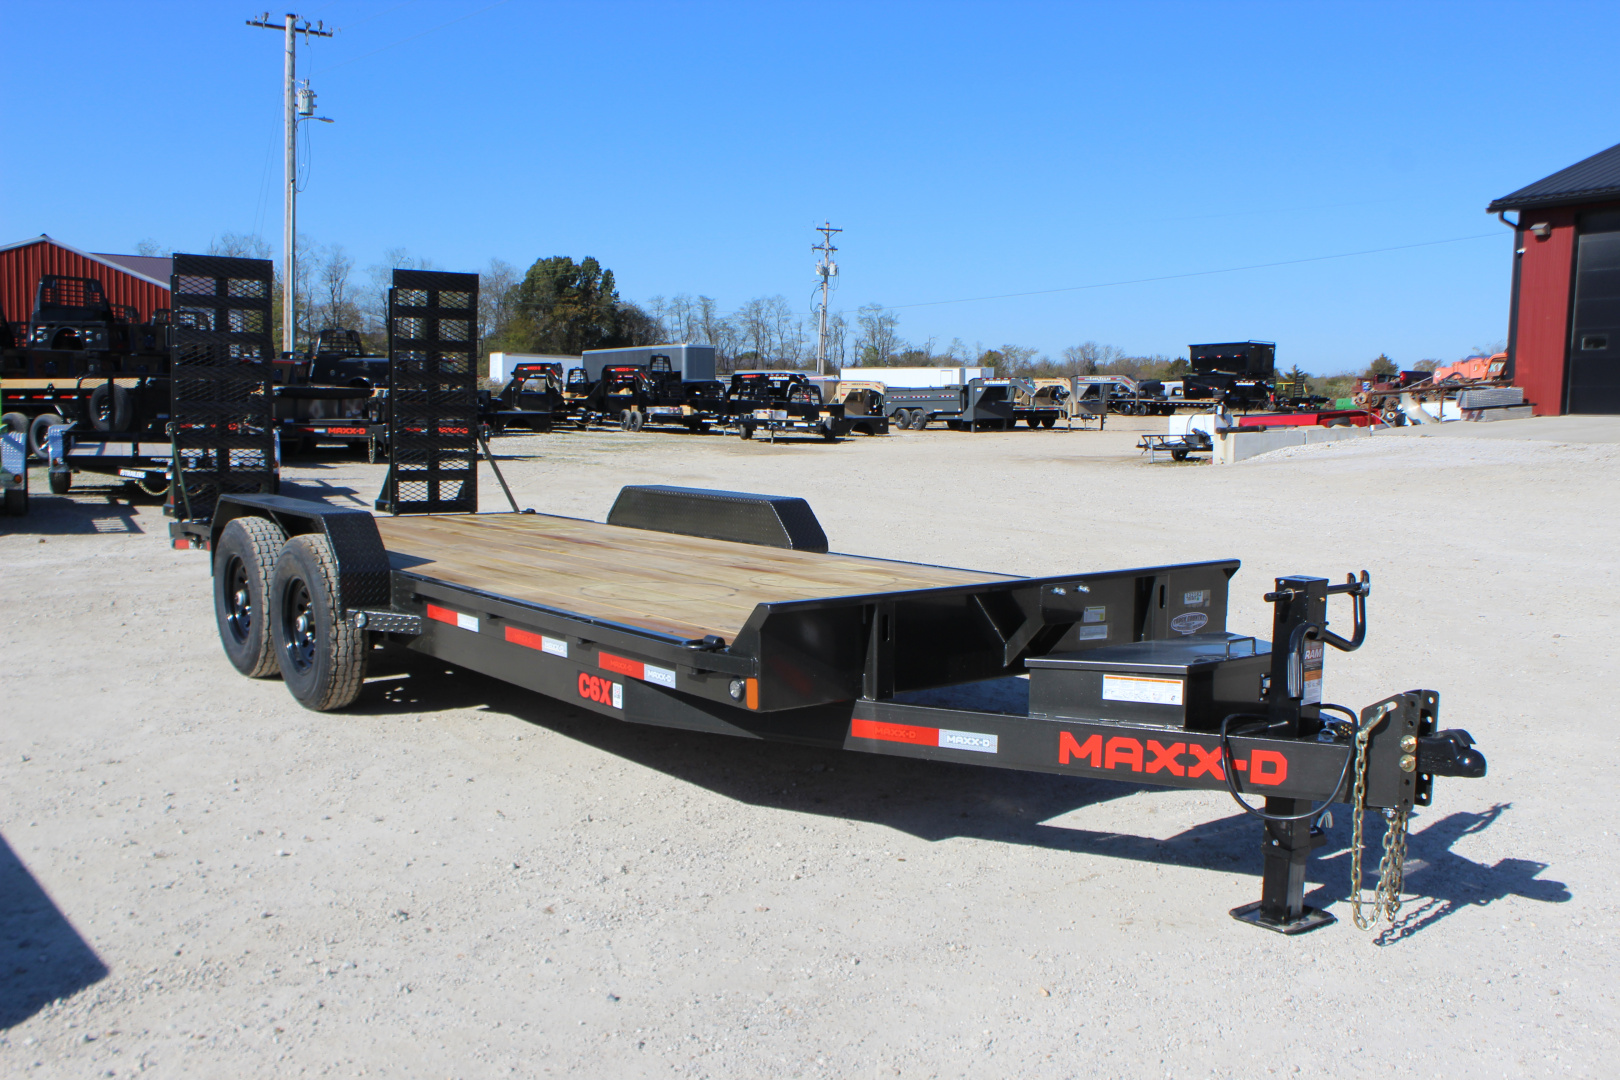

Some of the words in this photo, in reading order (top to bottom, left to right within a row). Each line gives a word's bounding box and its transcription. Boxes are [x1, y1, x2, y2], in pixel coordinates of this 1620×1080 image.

[327, 427, 367, 435] MAXX-D
[1304, 648, 1323, 660] RAM
[647, 670, 672, 682] MAXX-D
[578, 672, 613, 706] C6X
[874, 726, 917, 739] MAXX-D
[946, 735, 990, 747] MAXX-D
[1058, 730, 1289, 787] MAXX-D
